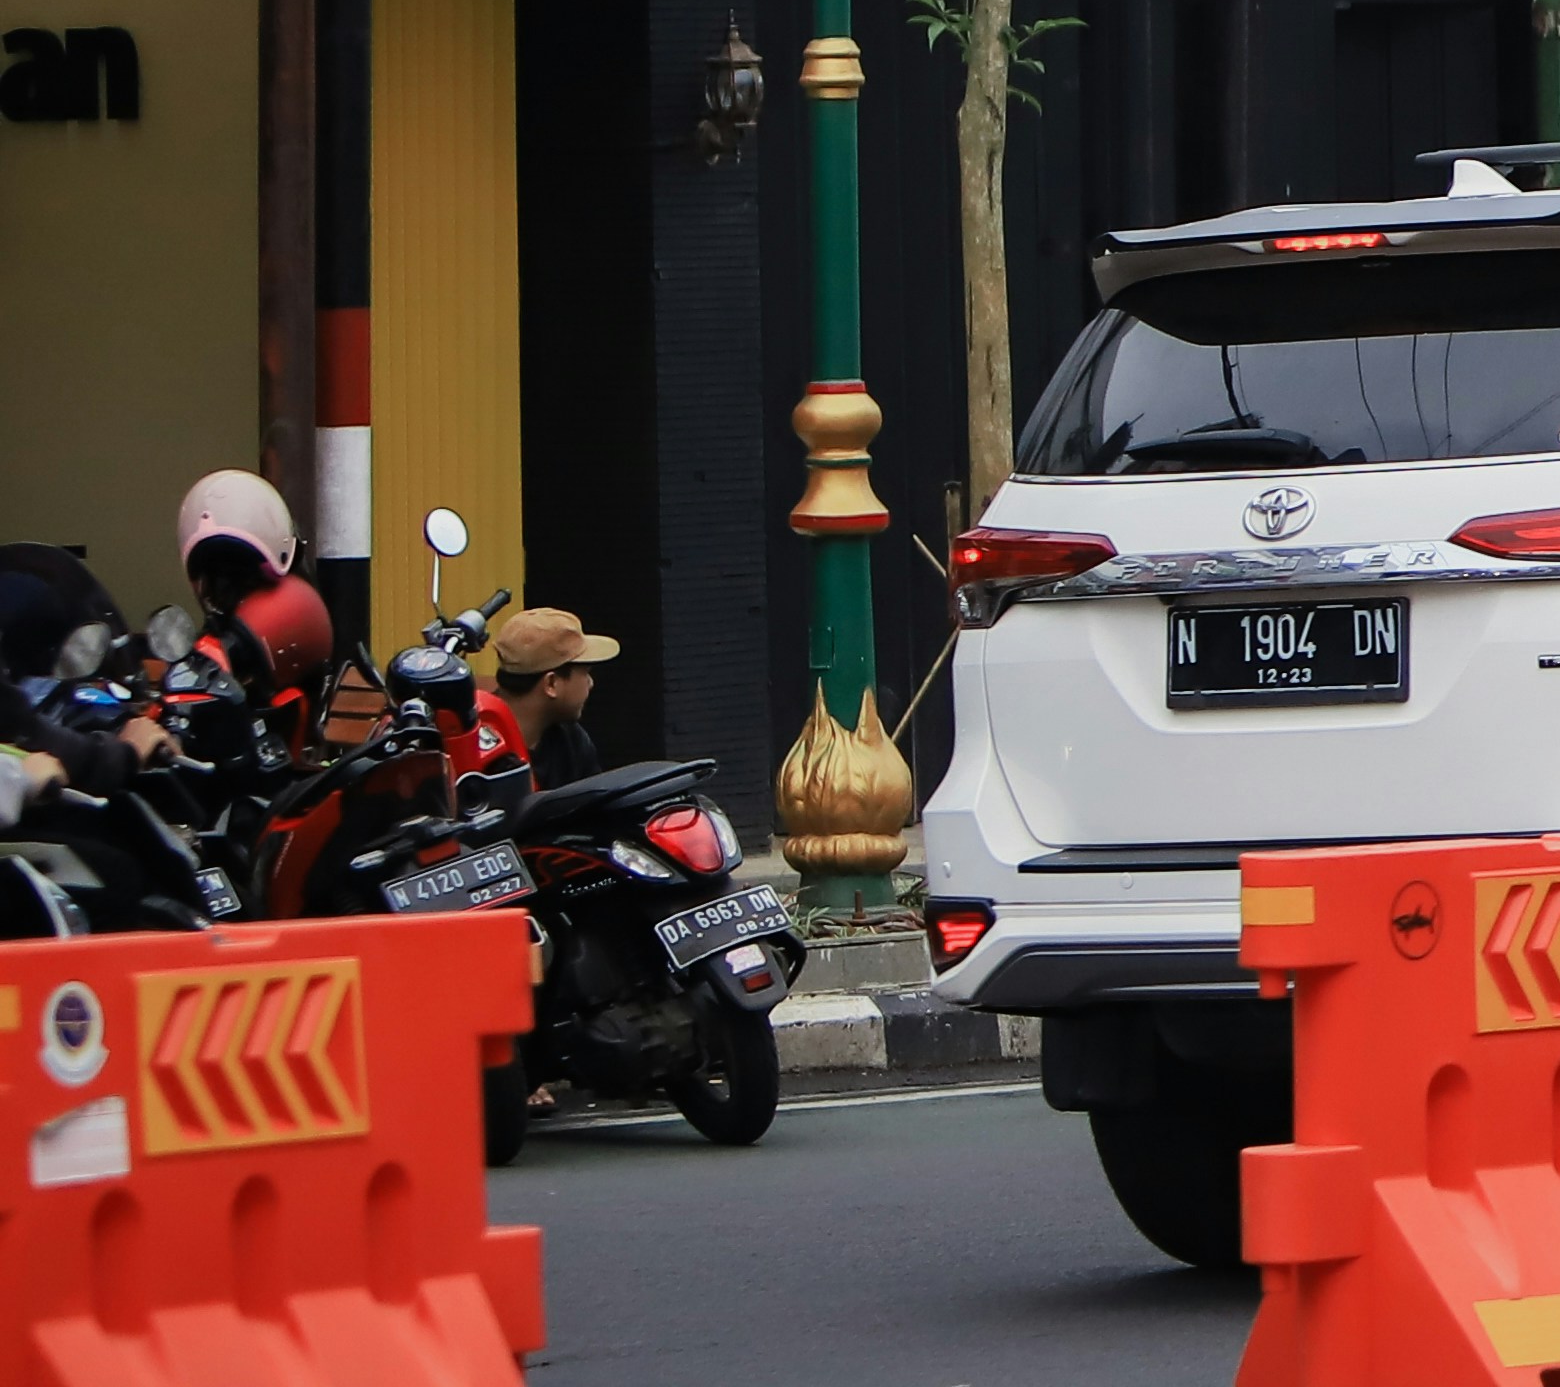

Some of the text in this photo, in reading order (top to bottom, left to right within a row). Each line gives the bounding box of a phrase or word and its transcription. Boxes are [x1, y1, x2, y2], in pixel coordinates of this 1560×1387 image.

[1178, 608, 1396, 664] N 1904 DN
[416, 869, 465, 901] 4120
[473, 853, 512, 882] EDC
[662, 888, 778, 944] DA 6963 DN
